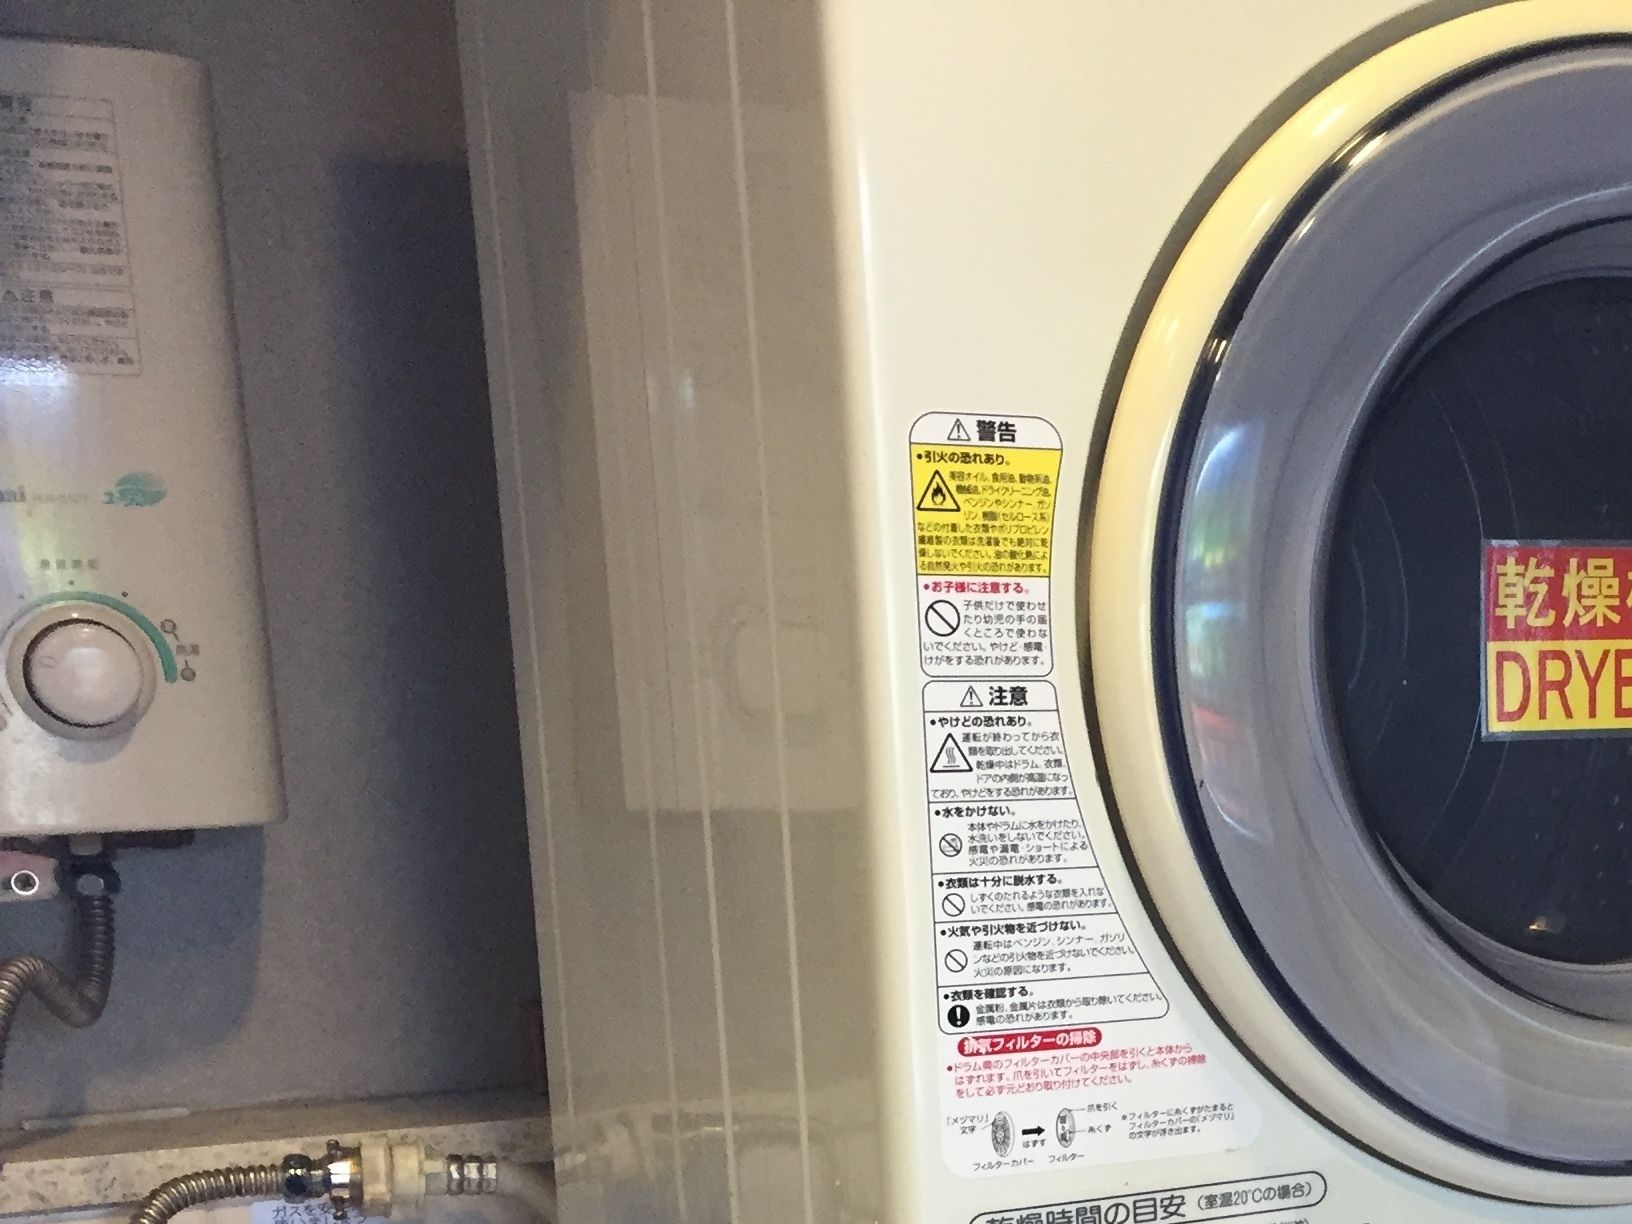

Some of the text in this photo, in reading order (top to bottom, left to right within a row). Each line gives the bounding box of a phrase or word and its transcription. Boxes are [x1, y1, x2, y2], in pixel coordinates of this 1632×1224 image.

[977, 421, 1017, 442] 警告
[924, 451, 1010, 465] 引火の恐れあり。
[932, 582, 1029, 594] お子様に注意する。
[964, 600, 1046, 610] 子供だけで使わせ
[964, 614, 1048, 624] たり幼児の手の届
[964, 628, 1048, 638] くところで使わな
[924, 656, 1044, 665] けがをする恐れがあります。
[989, 687, 1028, 706] 注意
[938, 716, 1032, 727] やけどの恐れあり。
[962, 733, 1060, 742] 運転が終わってから衣
[976, 773, 1068, 783] ドアの内側が高温になっ
[942, 806, 1016, 818] 水をかけない。
[968, 831, 1086, 843] 水洗いをしないでください。
[969, 854, 1067, 866] 火災の恐れがあります。
[945, 875, 1062, 889] 衣類は十分に脱水する。
[971, 888, 1104, 902] しずくのたれるような衣類を入れな
[971, 899, 1111, 914] いでください。感電の恐れがあります。
[948, 921, 1087, 937] 火気や引火物を近づけない。
[975, 965, 1071, 977] 火災の原因になります。
[951, 987, 1033, 1001] 衣類を確認する。
[976, 1013, 1074, 1026] 感電の恐れがあります。
[955, 1076, 1132, 1098] をして必ず元どおり取り付けてください。
[1048, 1151, 1085, 1163] フィルター
[972, 1158, 1034, 1171] フィルターカバー
